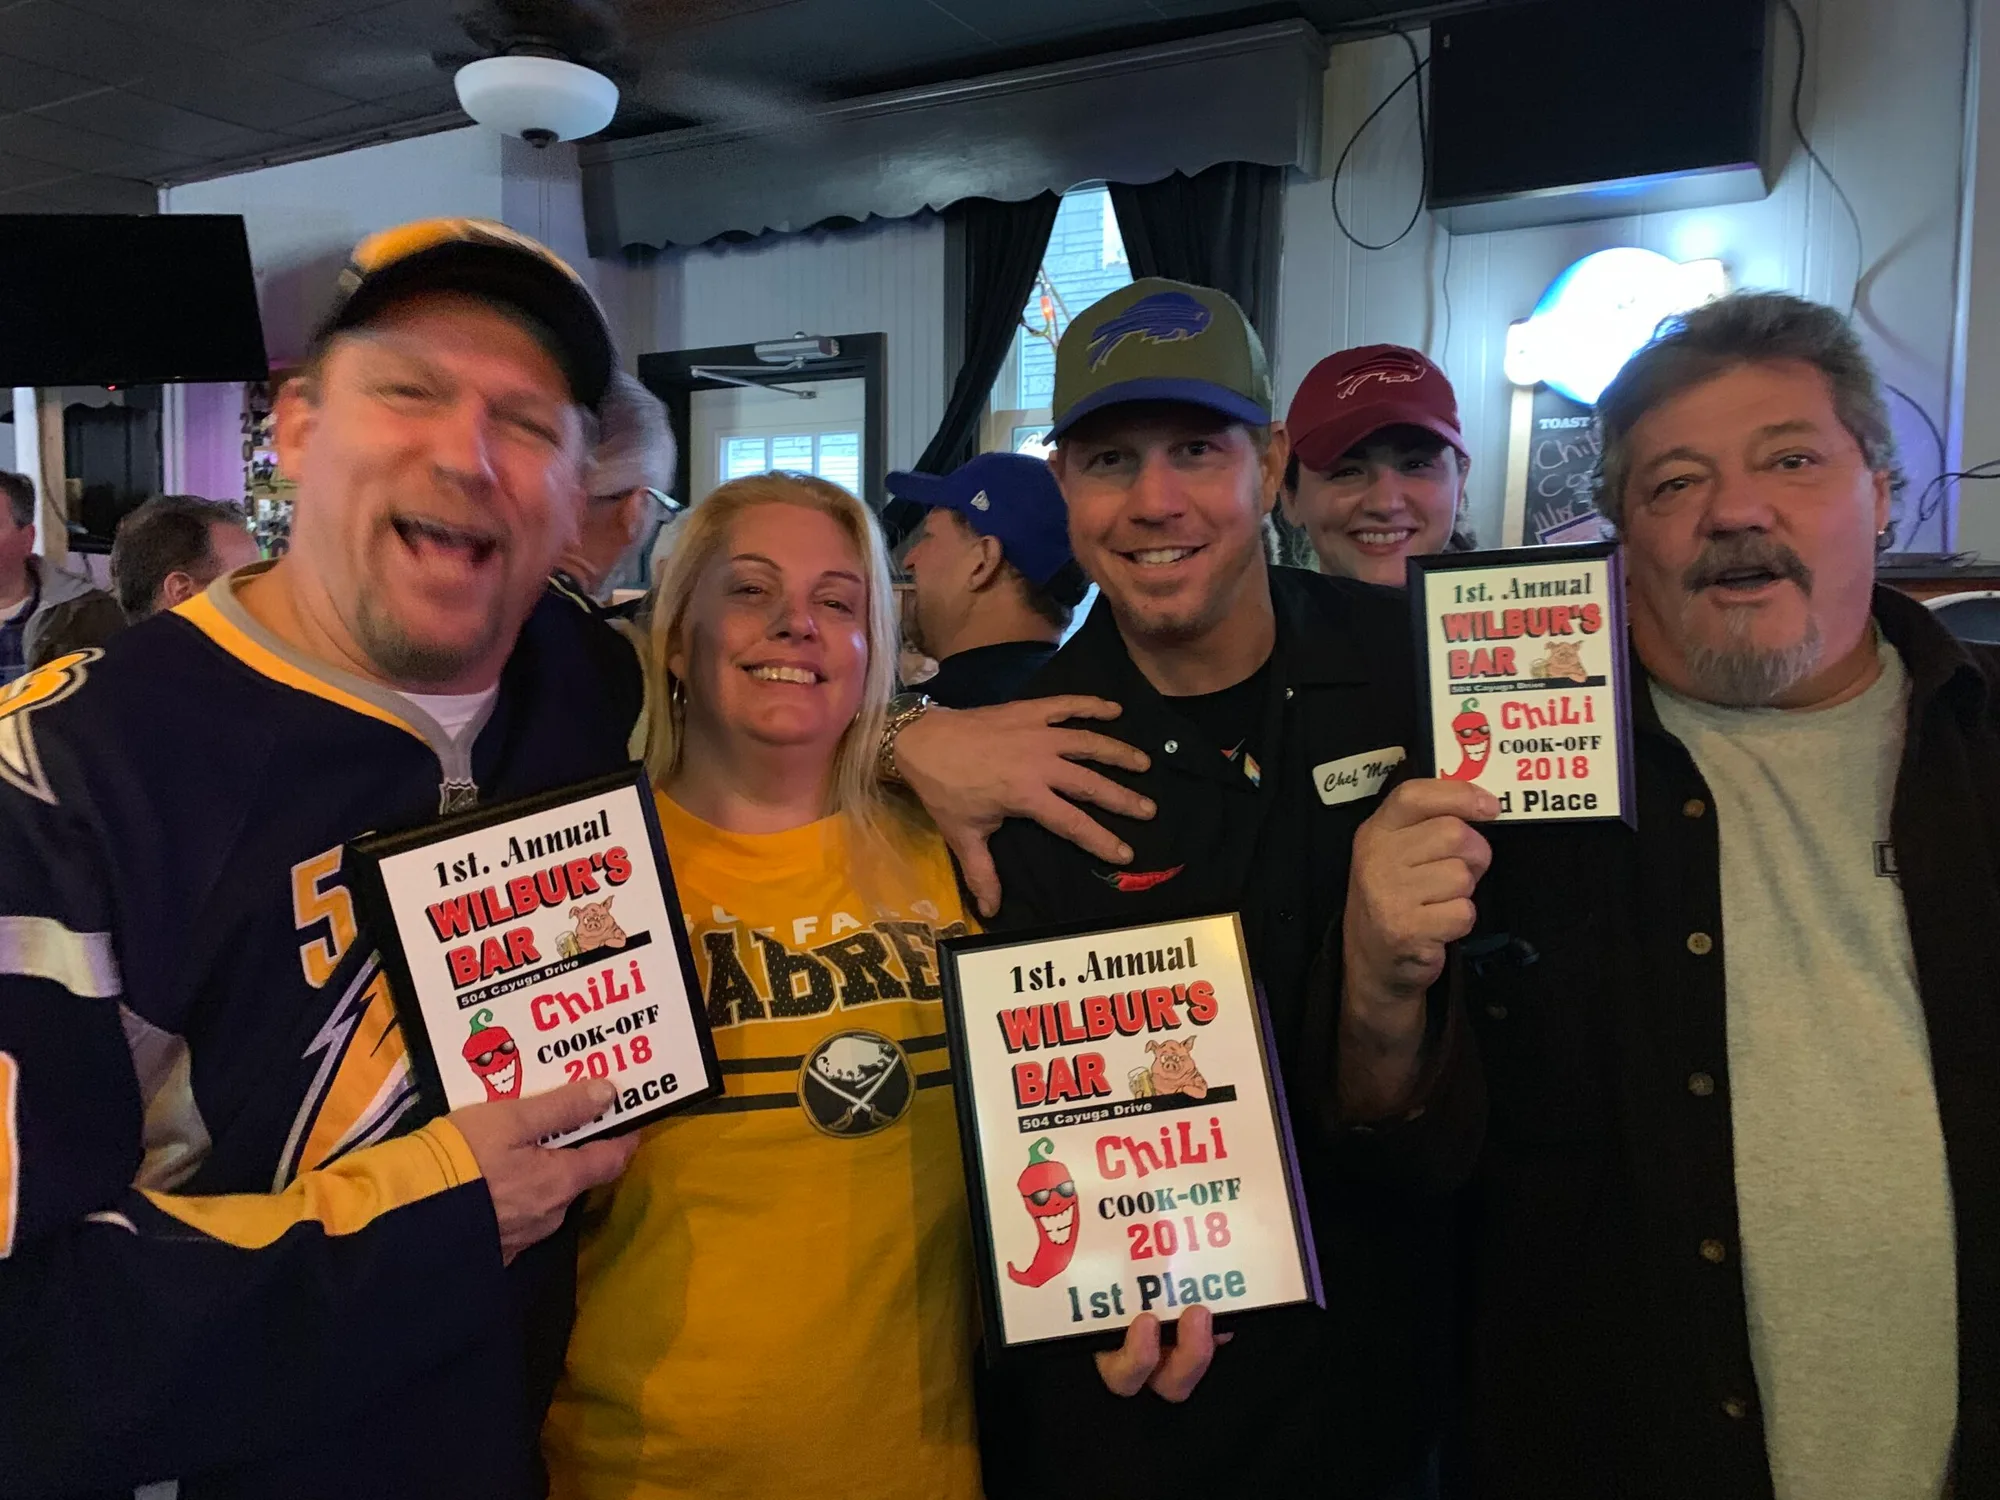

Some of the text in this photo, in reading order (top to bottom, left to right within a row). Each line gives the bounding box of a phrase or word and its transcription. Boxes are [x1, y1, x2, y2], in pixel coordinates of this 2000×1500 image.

[1453, 573, 1592, 604] 1st. Annual
[1441, 603, 1603, 643] WILBUR'S
[1448, 646, 1517, 679] BAR
[1499, 735, 1603, 755] COOK-OFF
[1517, 756, 1590, 781] 2018
[1323, 768, 1359, 793] Chef
[1524, 790, 1598, 812] Place
[433, 809, 612, 888] 1st. Annual
[425, 846, 632, 943] WILBUR'S
[445, 926, 541, 990] BAR
[1010, 936, 1198, 993] 1st. Annual
[460, 959, 579, 1008] 504 Cayuga Drive
[537, 1005, 660, 1064] COOK-OFF
[997, 980, 1219, 1053] WILBUR'S
[564, 1035, 653, 1084] 2018
[1012, 1052, 1112, 1109] BAR
[602, 1072, 679, 1121] lace
[1022, 1101, 1152, 1130] 504 Cayuga Drive
[1099, 1177, 1241, 1220] COOK-OFF
[1128, 1211, 1231, 1261] 2018
[1068, 1270, 1246, 1323] 1st Place
